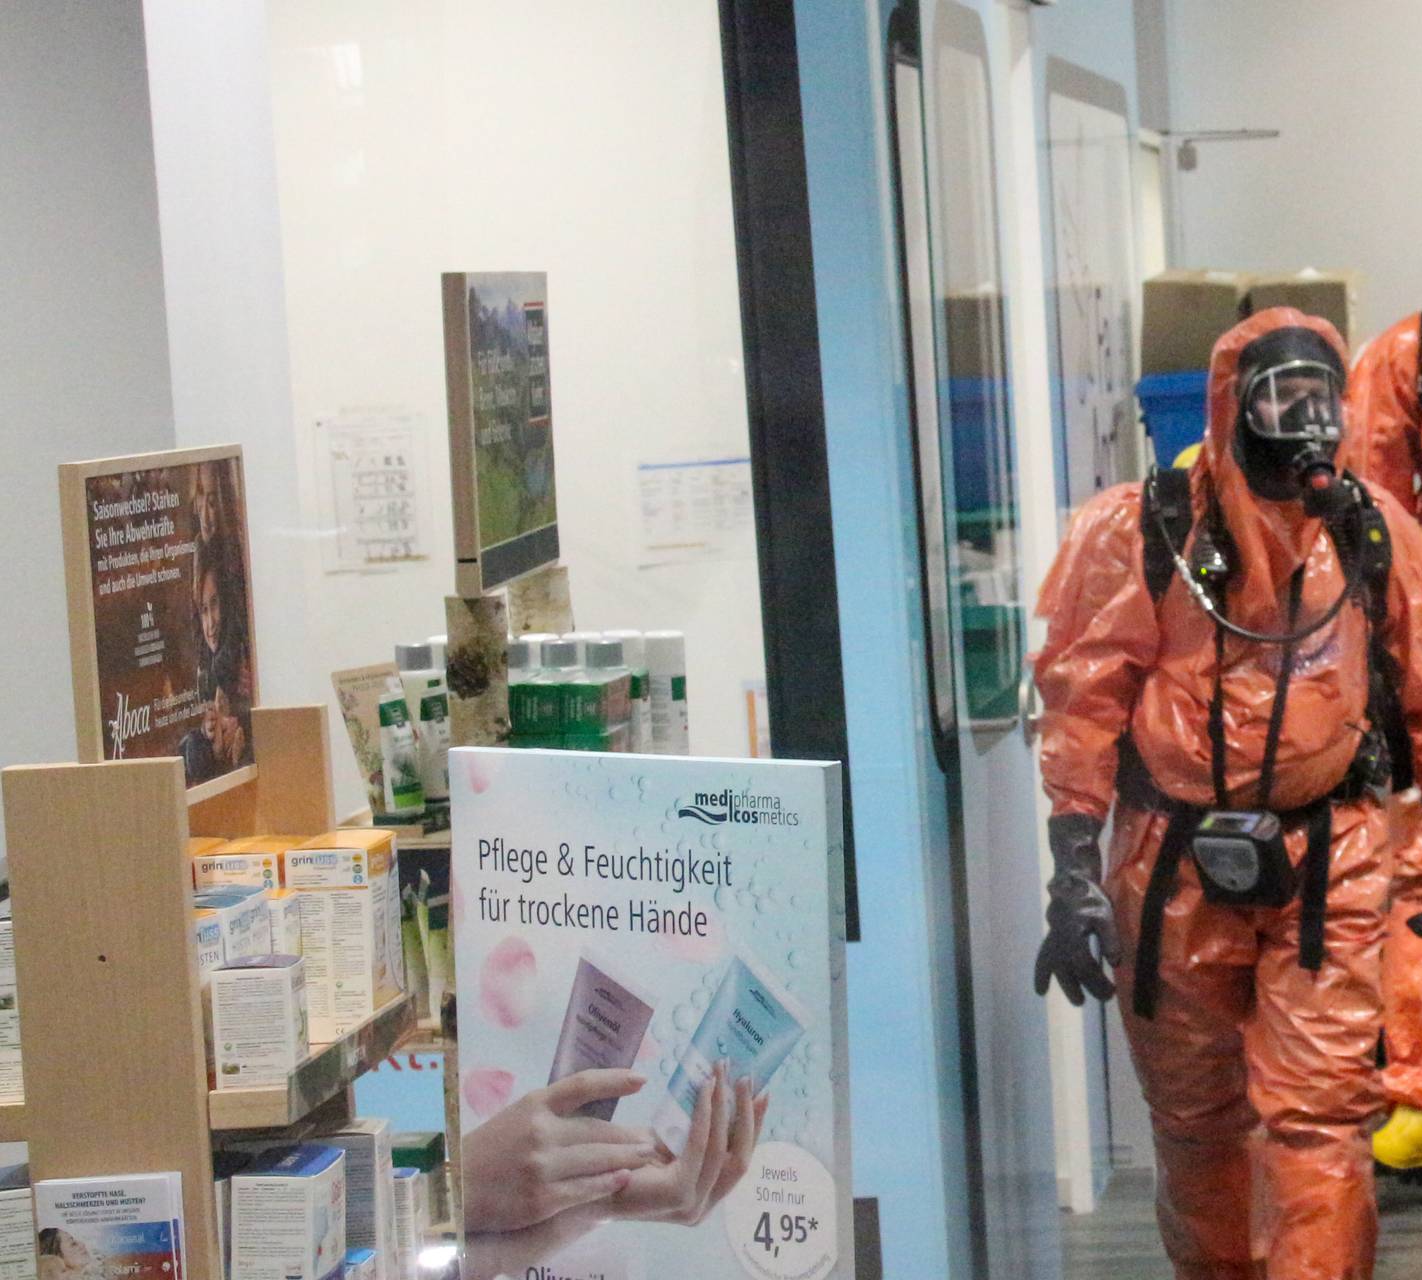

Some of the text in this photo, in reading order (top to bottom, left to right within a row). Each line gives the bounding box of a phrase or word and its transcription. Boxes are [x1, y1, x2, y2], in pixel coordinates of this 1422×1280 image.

[94, 489, 180, 520] Saisonwechsel? Stärken
[95, 515, 175, 549] Sie Ihre Abwehrkräfte
[478, 838, 733, 894] Pflege & Feuchtigkeit
[479, 887, 708, 937] für trockene Hände
[200, 951, 219, 966] STEN
[732, 1008, 764, 1046] Hyaluron
[760, 1165, 798, 1182] Jeweils
[756, 1186, 770, 1201] 50
[788, 1192, 805, 1205] nur
